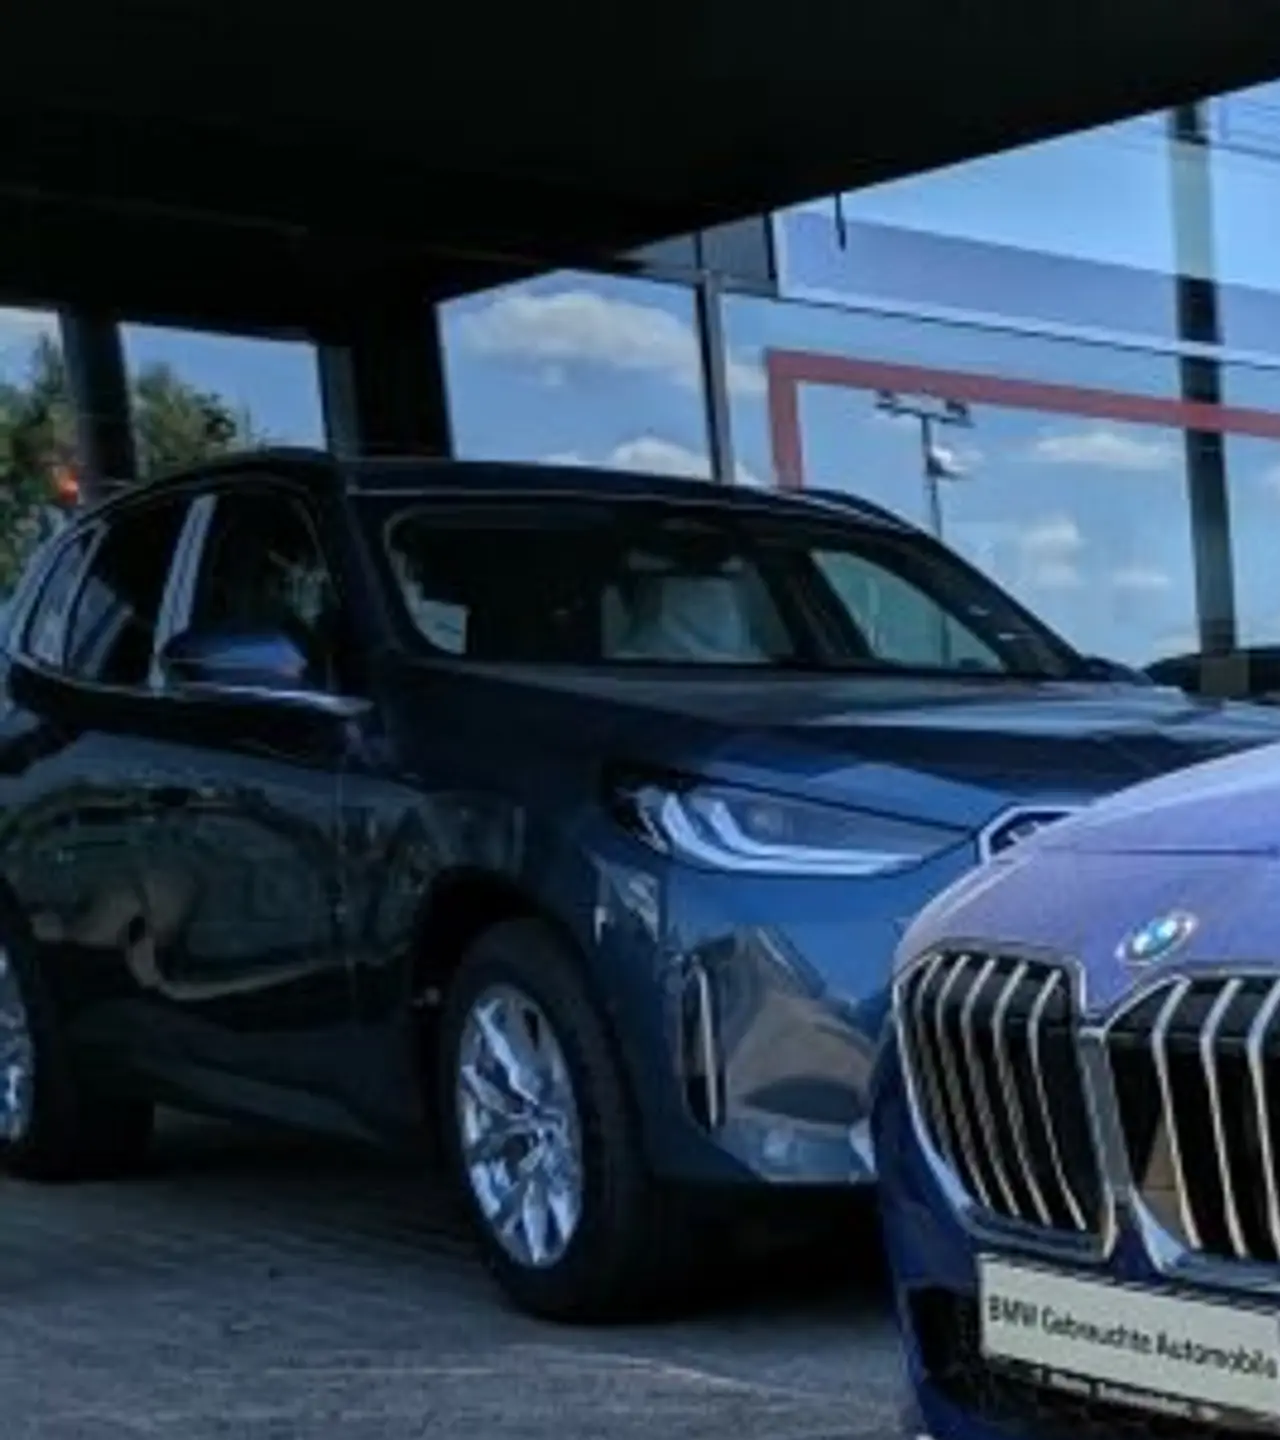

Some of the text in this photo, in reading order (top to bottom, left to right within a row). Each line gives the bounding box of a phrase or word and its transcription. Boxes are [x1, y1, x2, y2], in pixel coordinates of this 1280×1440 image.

[988, 1295, 1278, 1380] BMW Gebrauchte Automobile
